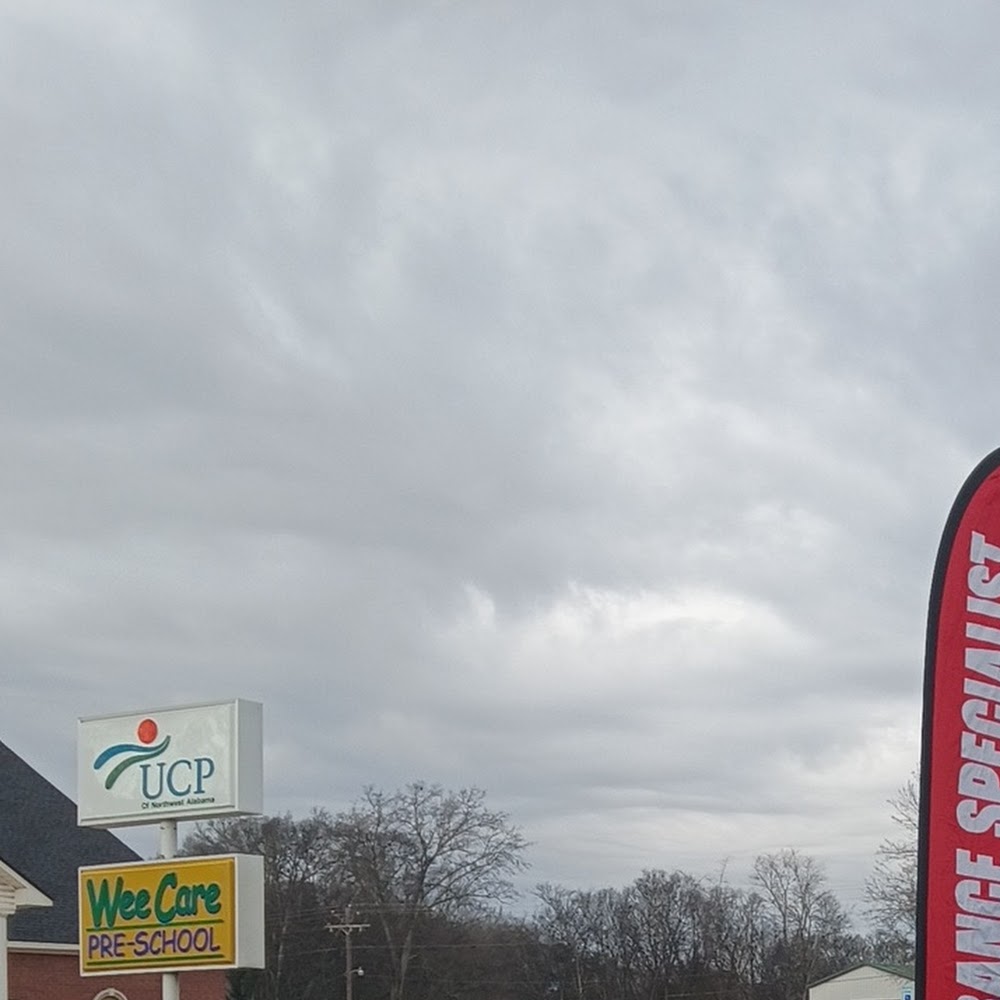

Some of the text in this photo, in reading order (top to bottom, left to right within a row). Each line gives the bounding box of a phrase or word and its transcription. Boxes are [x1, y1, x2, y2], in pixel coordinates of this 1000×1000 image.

[140, 757, 215, 800] UCP
[87, 872, 222, 928] Wee Care
[88, 927, 221, 958] PRE-SCHOOL
